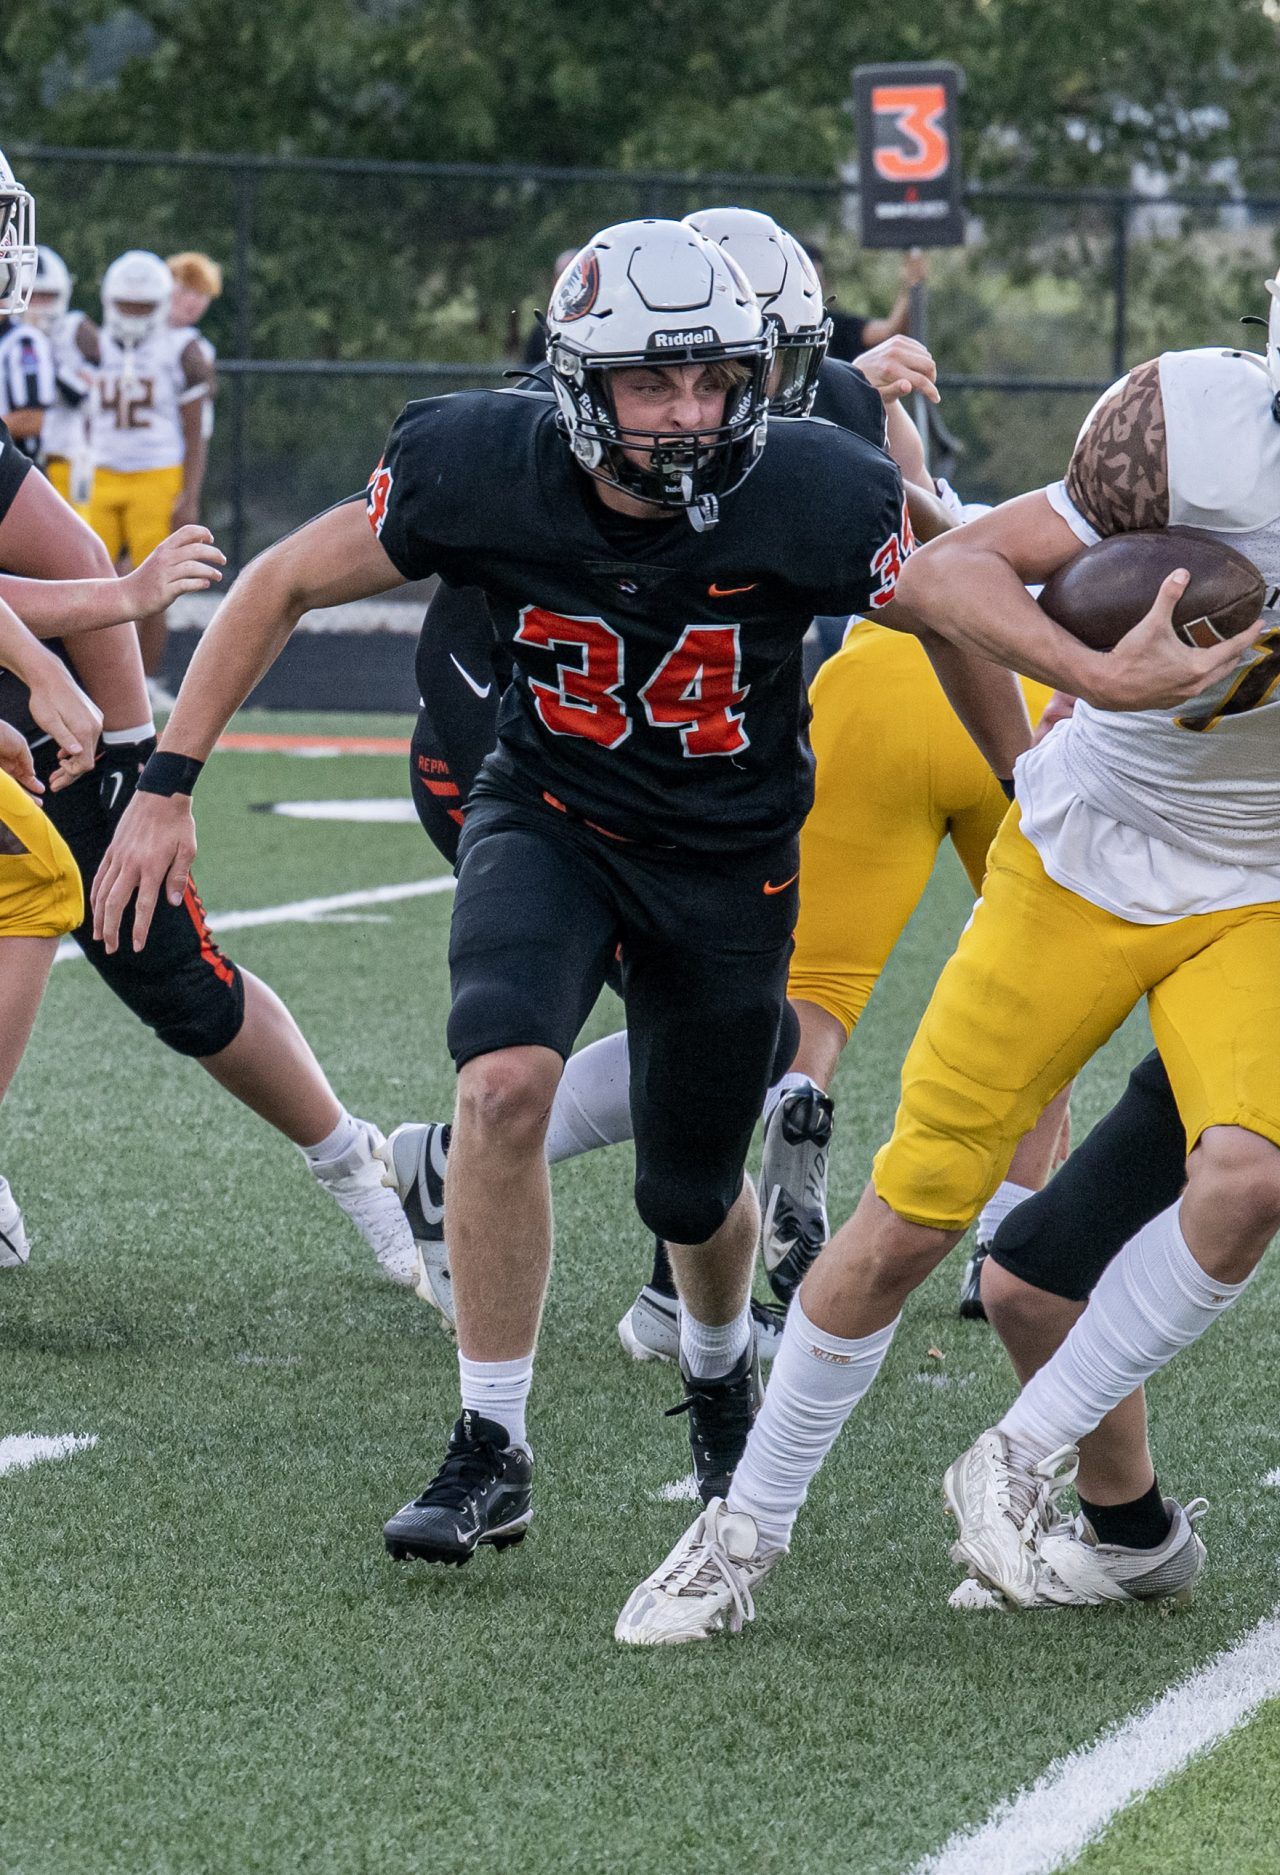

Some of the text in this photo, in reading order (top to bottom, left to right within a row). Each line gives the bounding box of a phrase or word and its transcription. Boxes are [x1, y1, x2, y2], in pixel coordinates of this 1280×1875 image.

[871, 84, 950, 183] 3
[654, 328, 714, 348] Riddell
[100, 376, 154, 430] 42
[513, 604, 751, 758] 34
